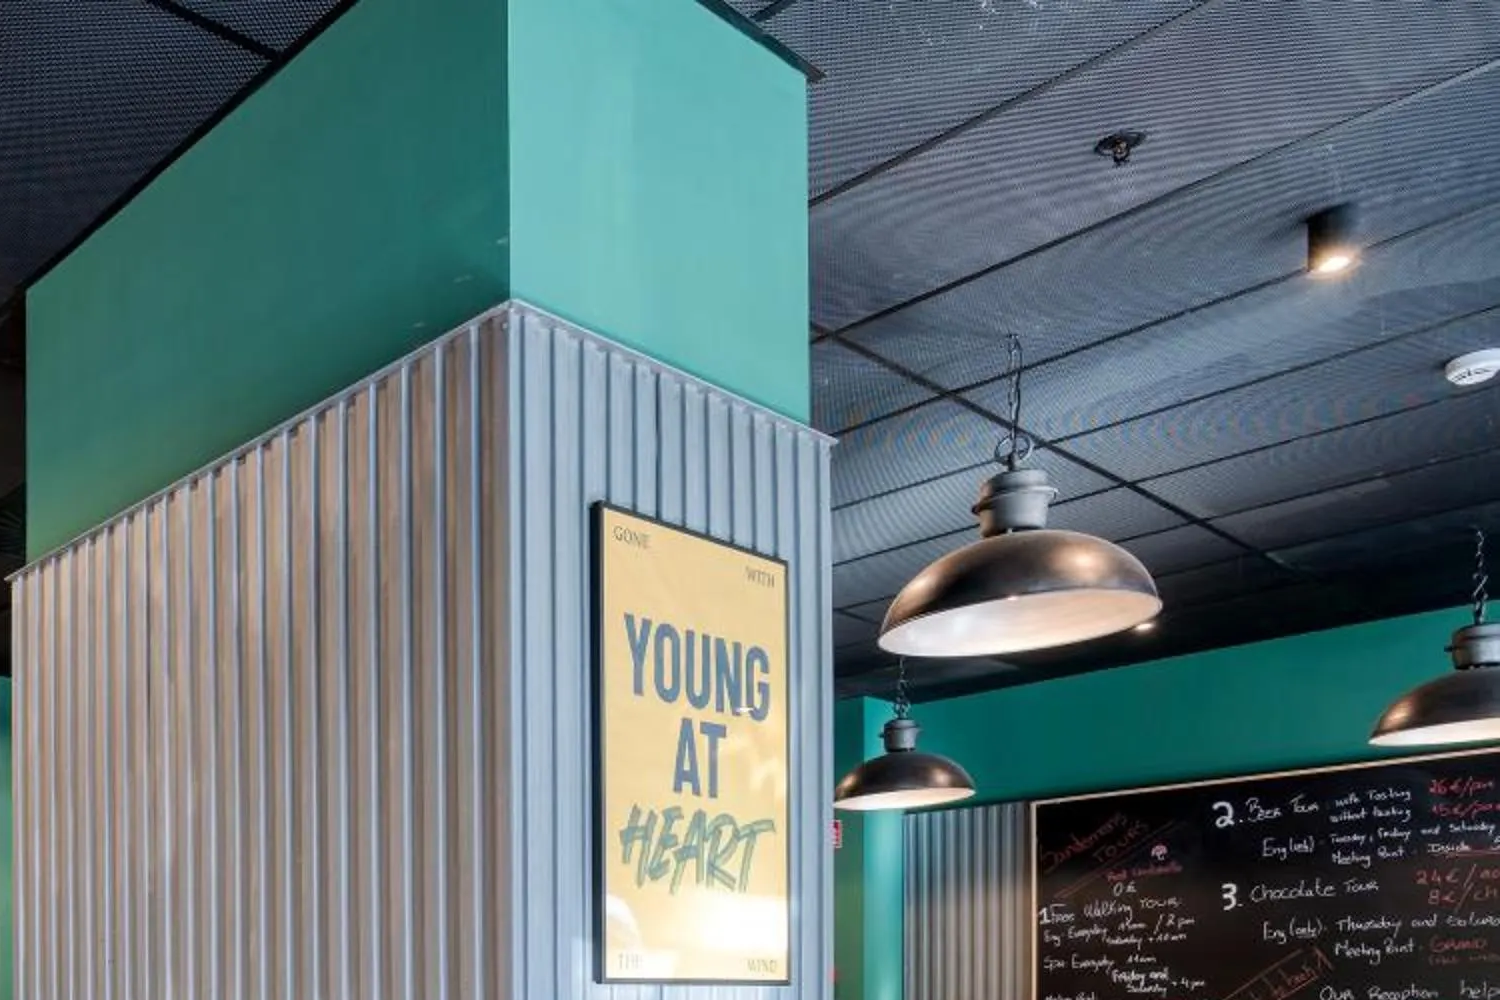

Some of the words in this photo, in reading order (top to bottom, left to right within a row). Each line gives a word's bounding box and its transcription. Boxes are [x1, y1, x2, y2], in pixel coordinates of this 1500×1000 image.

[613, 525, 651, 549] GONE
[746, 566, 776, 588] WITH
[624, 612, 771, 723] YOUNG
[673, 717, 727, 799] AT
[1420, 824, 1440, 836] and
[619, 803, 777, 896] HEART
[1250, 876, 1336, 903] Chocolate
[1411, 911, 1438, 927] and
[747, 958, 778, 974] WIND
